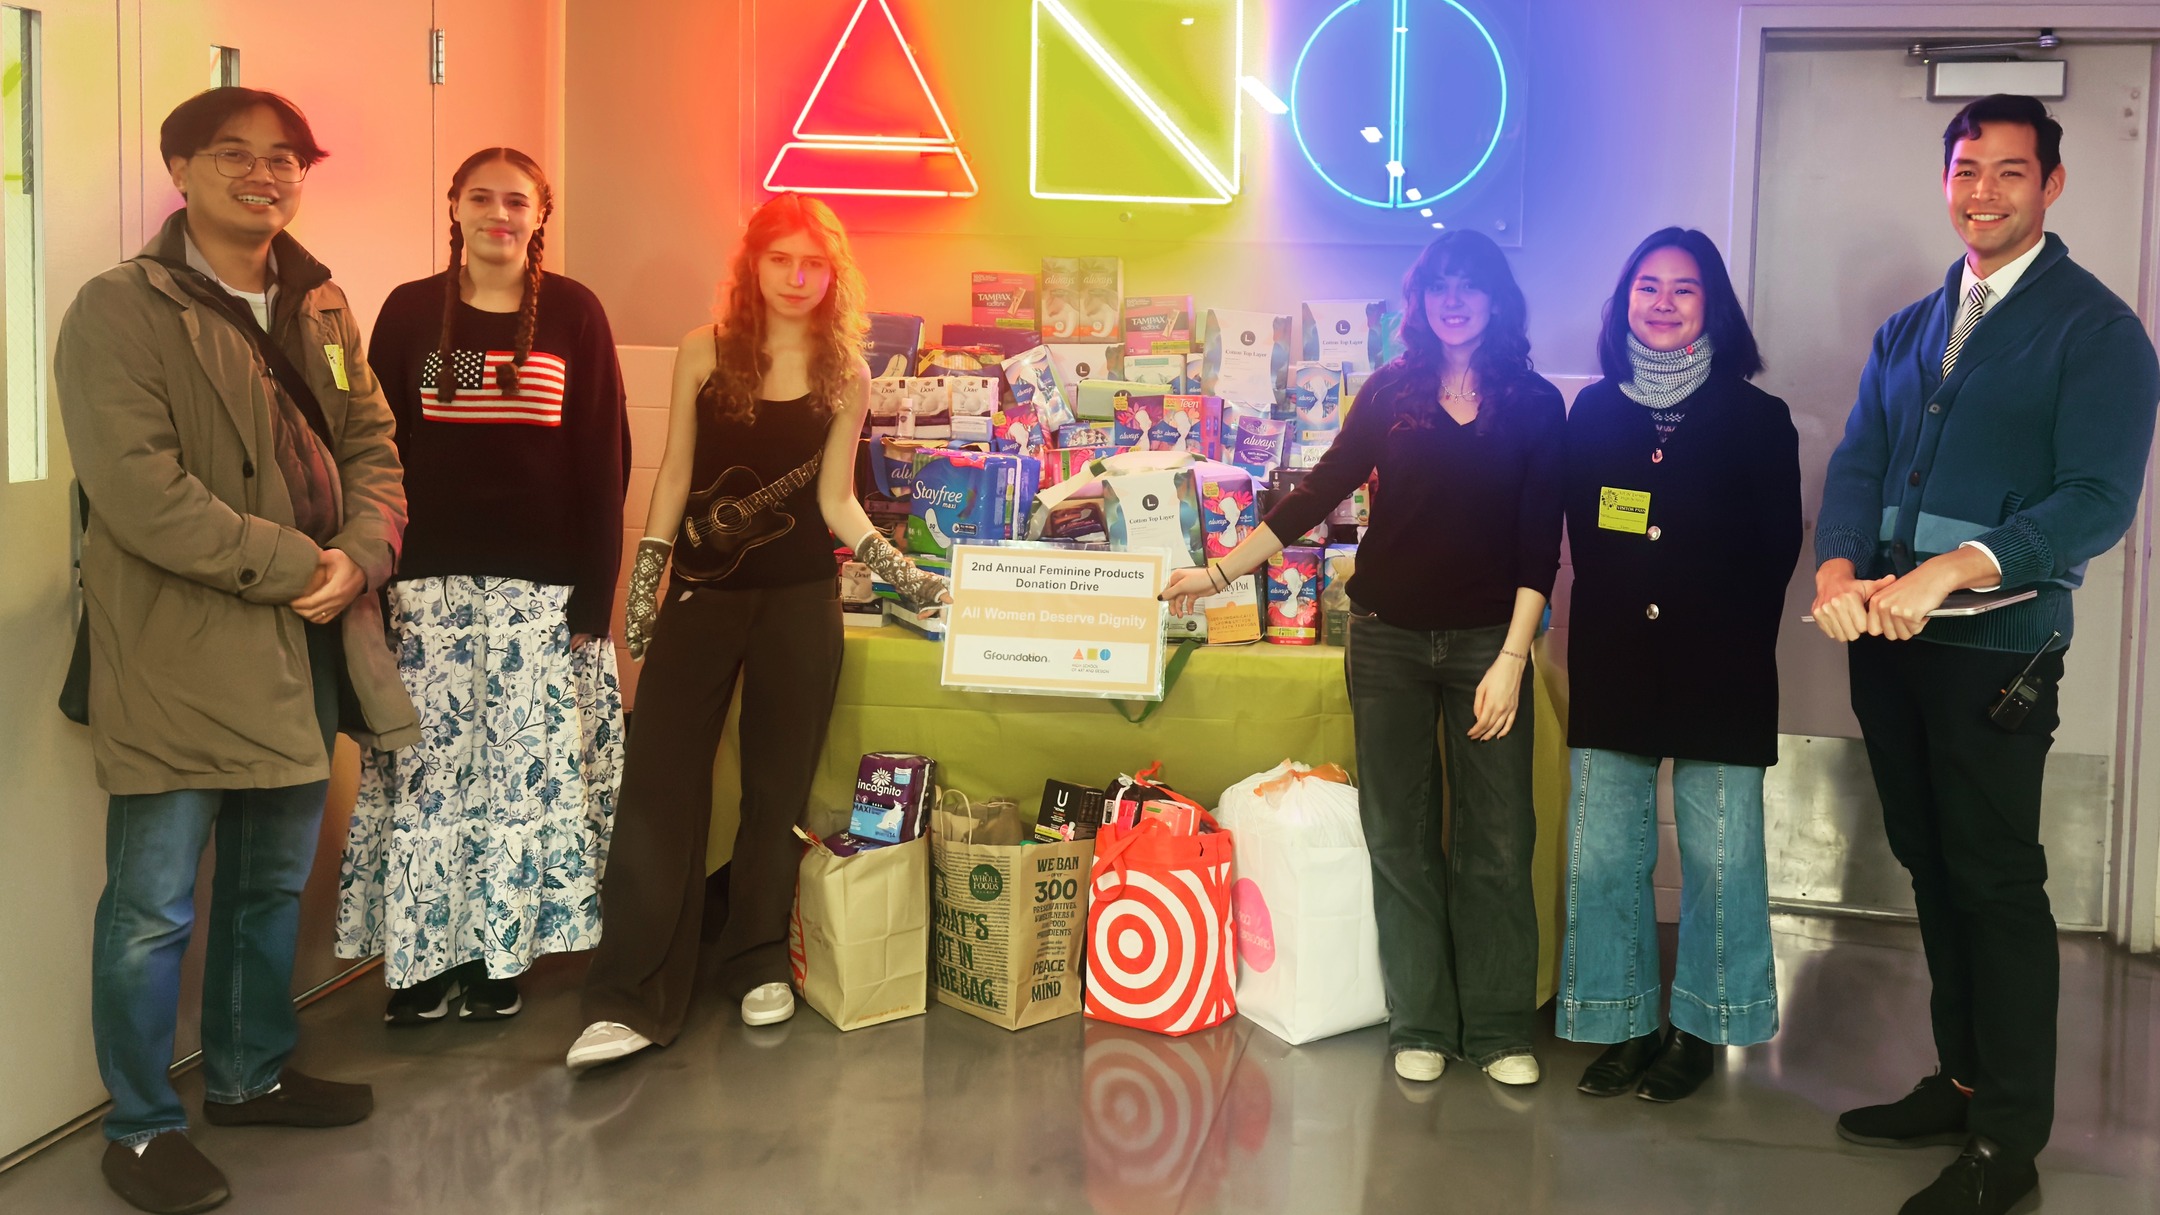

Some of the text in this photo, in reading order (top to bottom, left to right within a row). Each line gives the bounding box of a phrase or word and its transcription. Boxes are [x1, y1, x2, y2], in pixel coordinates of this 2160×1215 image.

[1045, 274, 1074, 287] always
[1083, 273, 1113, 287] always
[977, 293, 1011, 301] TAMPAX
[1131, 315, 1166, 326] TAMPAX
[881, 386, 896, 394] Dove
[963, 385, 978, 393] Dove
[1180, 398, 1199, 409] Teen
[1119, 431, 1140, 441] always
[1243, 435, 1277, 450] always
[912, 480, 963, 505] Stayfree
[942, 502, 957, 510] maxi
[1129, 517, 1148, 525] Cotton
[971, 562, 1145, 580] 2nd Annual Feminine Products
[1015, 578, 1100, 592] Donation Drive
[1270, 587, 1289, 596] always
[961, 605, 1147, 630] All Women Deserve Dignity
[857, 778, 902, 797] incognito
[1057, 789, 1069, 807] U
[854, 802, 871, 813] MAXI
[1037, 856, 1080, 873] WE BAN
[972, 874, 998, 883] WHOLE
[973, 882, 999, 891] FOODS
[1034, 878, 1078, 903] 300
[957, 940, 974, 970] IN
[1032, 959, 1066, 976] PEACE
[960, 971, 1000, 1009] BAG.
[1031, 980, 1062, 1003] MIND
